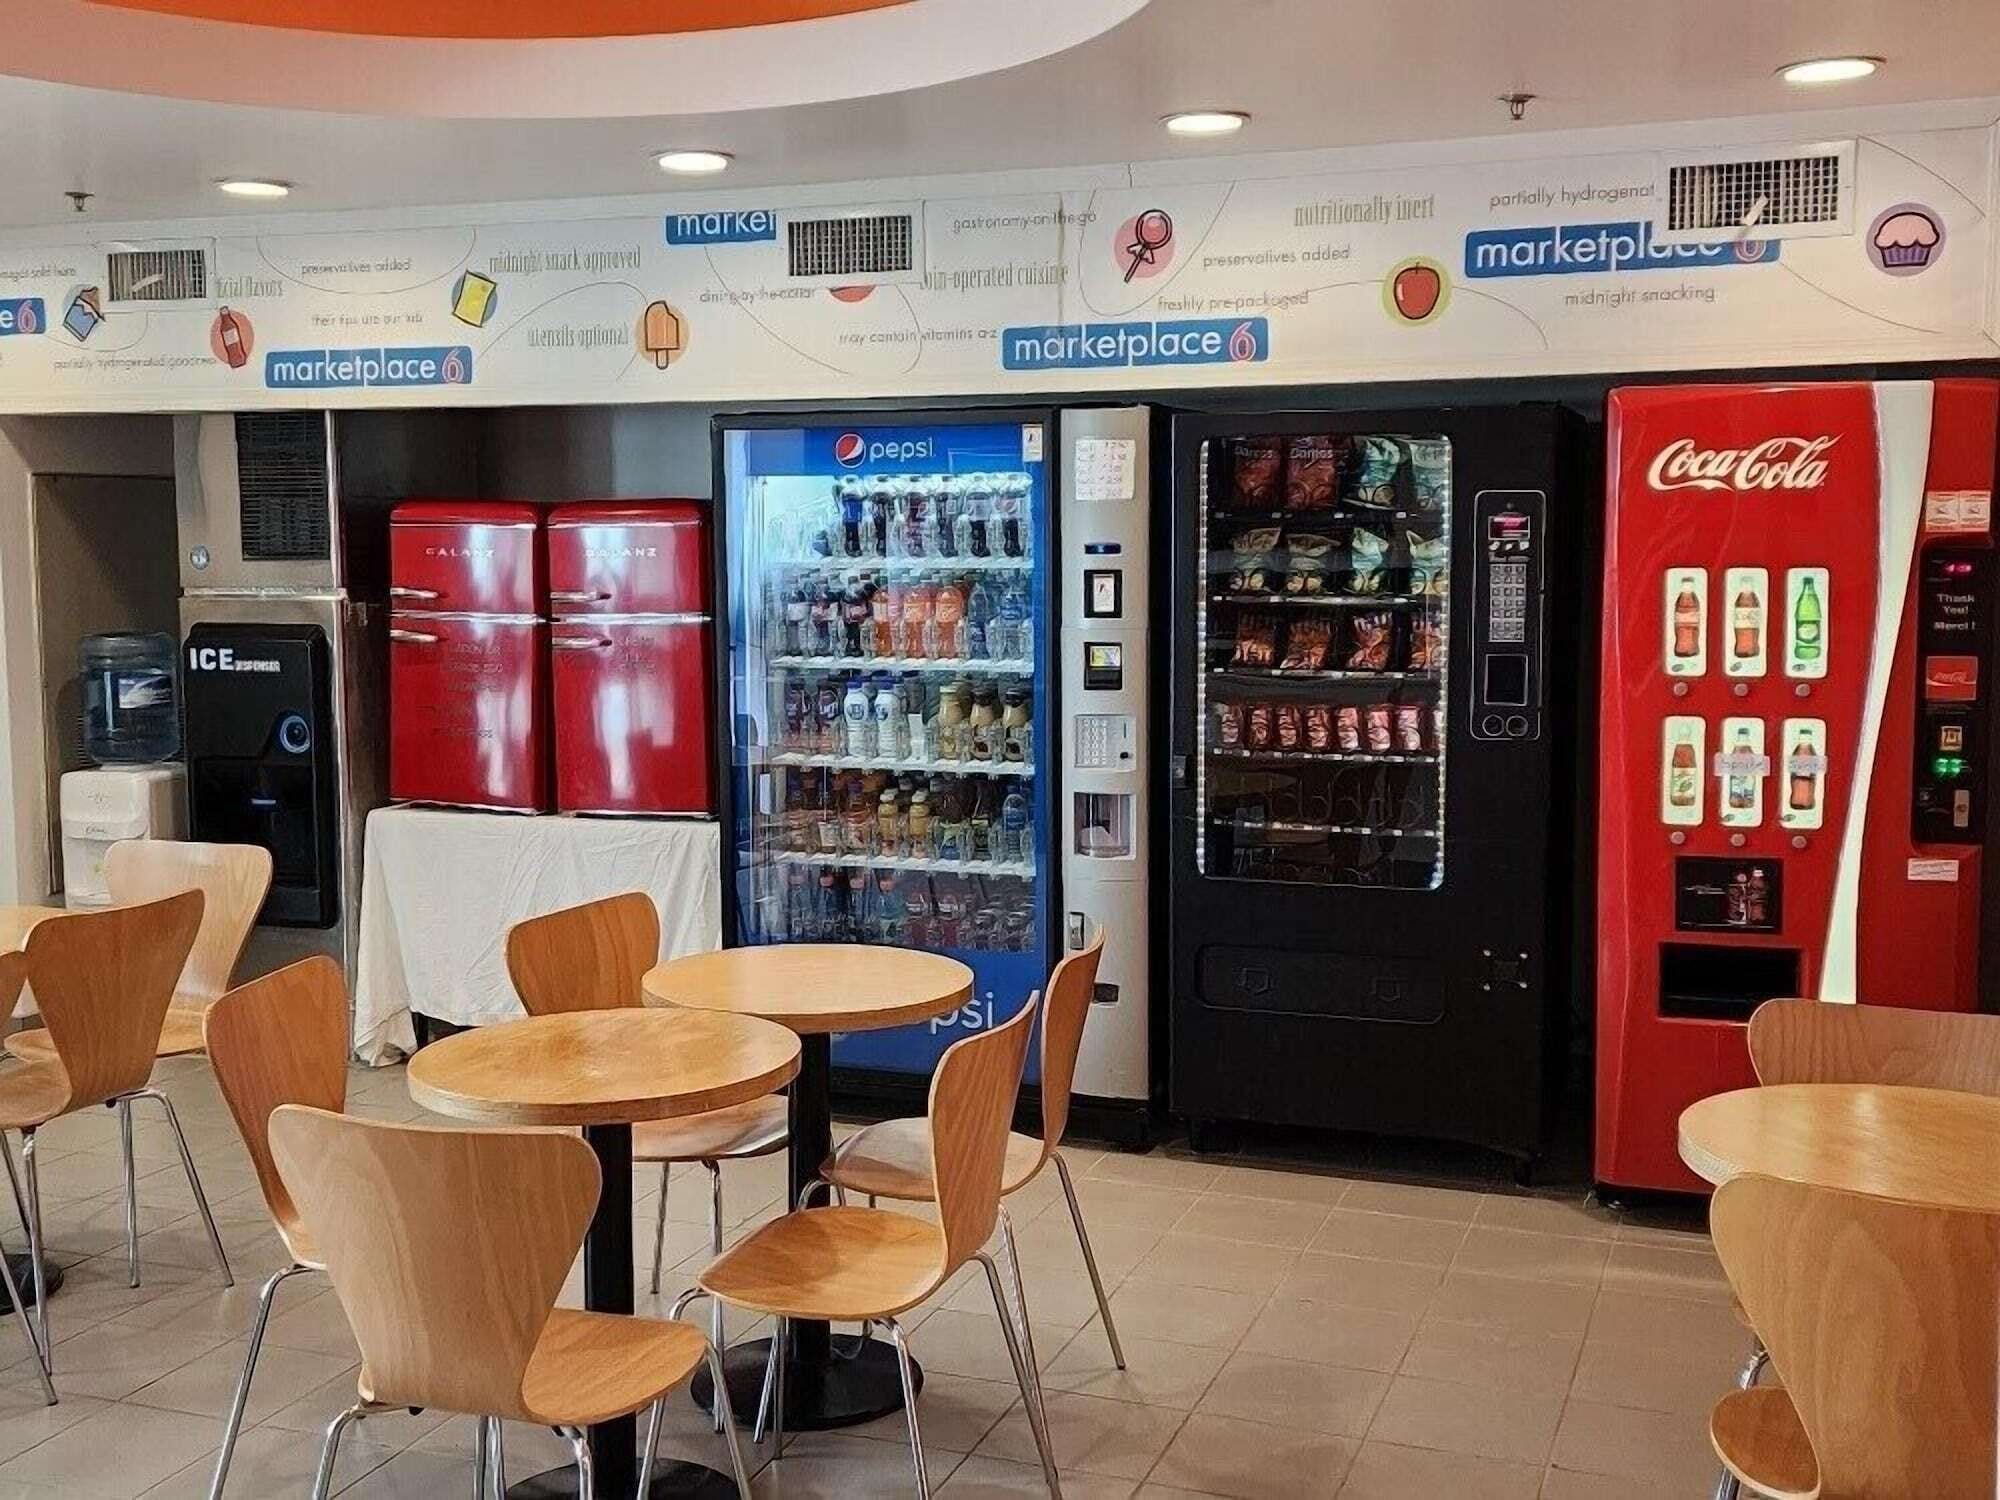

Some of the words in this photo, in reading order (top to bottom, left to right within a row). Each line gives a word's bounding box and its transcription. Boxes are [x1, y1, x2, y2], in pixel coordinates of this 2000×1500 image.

[1294, 197, 1393, 227] nutritionally
[1396, 194, 1435, 220] inert
[1489, 184, 1555, 210] partially
[584, 245, 642, 273] approved
[1203, 249, 1297, 269] preservatives
[1301, 244, 1350, 263] added
[920, 262, 1013, 292] oin-operated
[1158, 295, 1203, 313] freshly
[1564, 288, 1636, 308] midnight
[1640, 283, 1716, 303] snacking
[1014, 322, 1222, 367] marketplace
[1228, 321, 1257, 361] 6
[273, 348, 437, 387] marketplace
[442, 347, 465, 384] 6
[869, 435, 935, 464] pepsi
[1648, 431, 1847, 493] Coca-Cola
[189, 646, 235, 671] ICE
